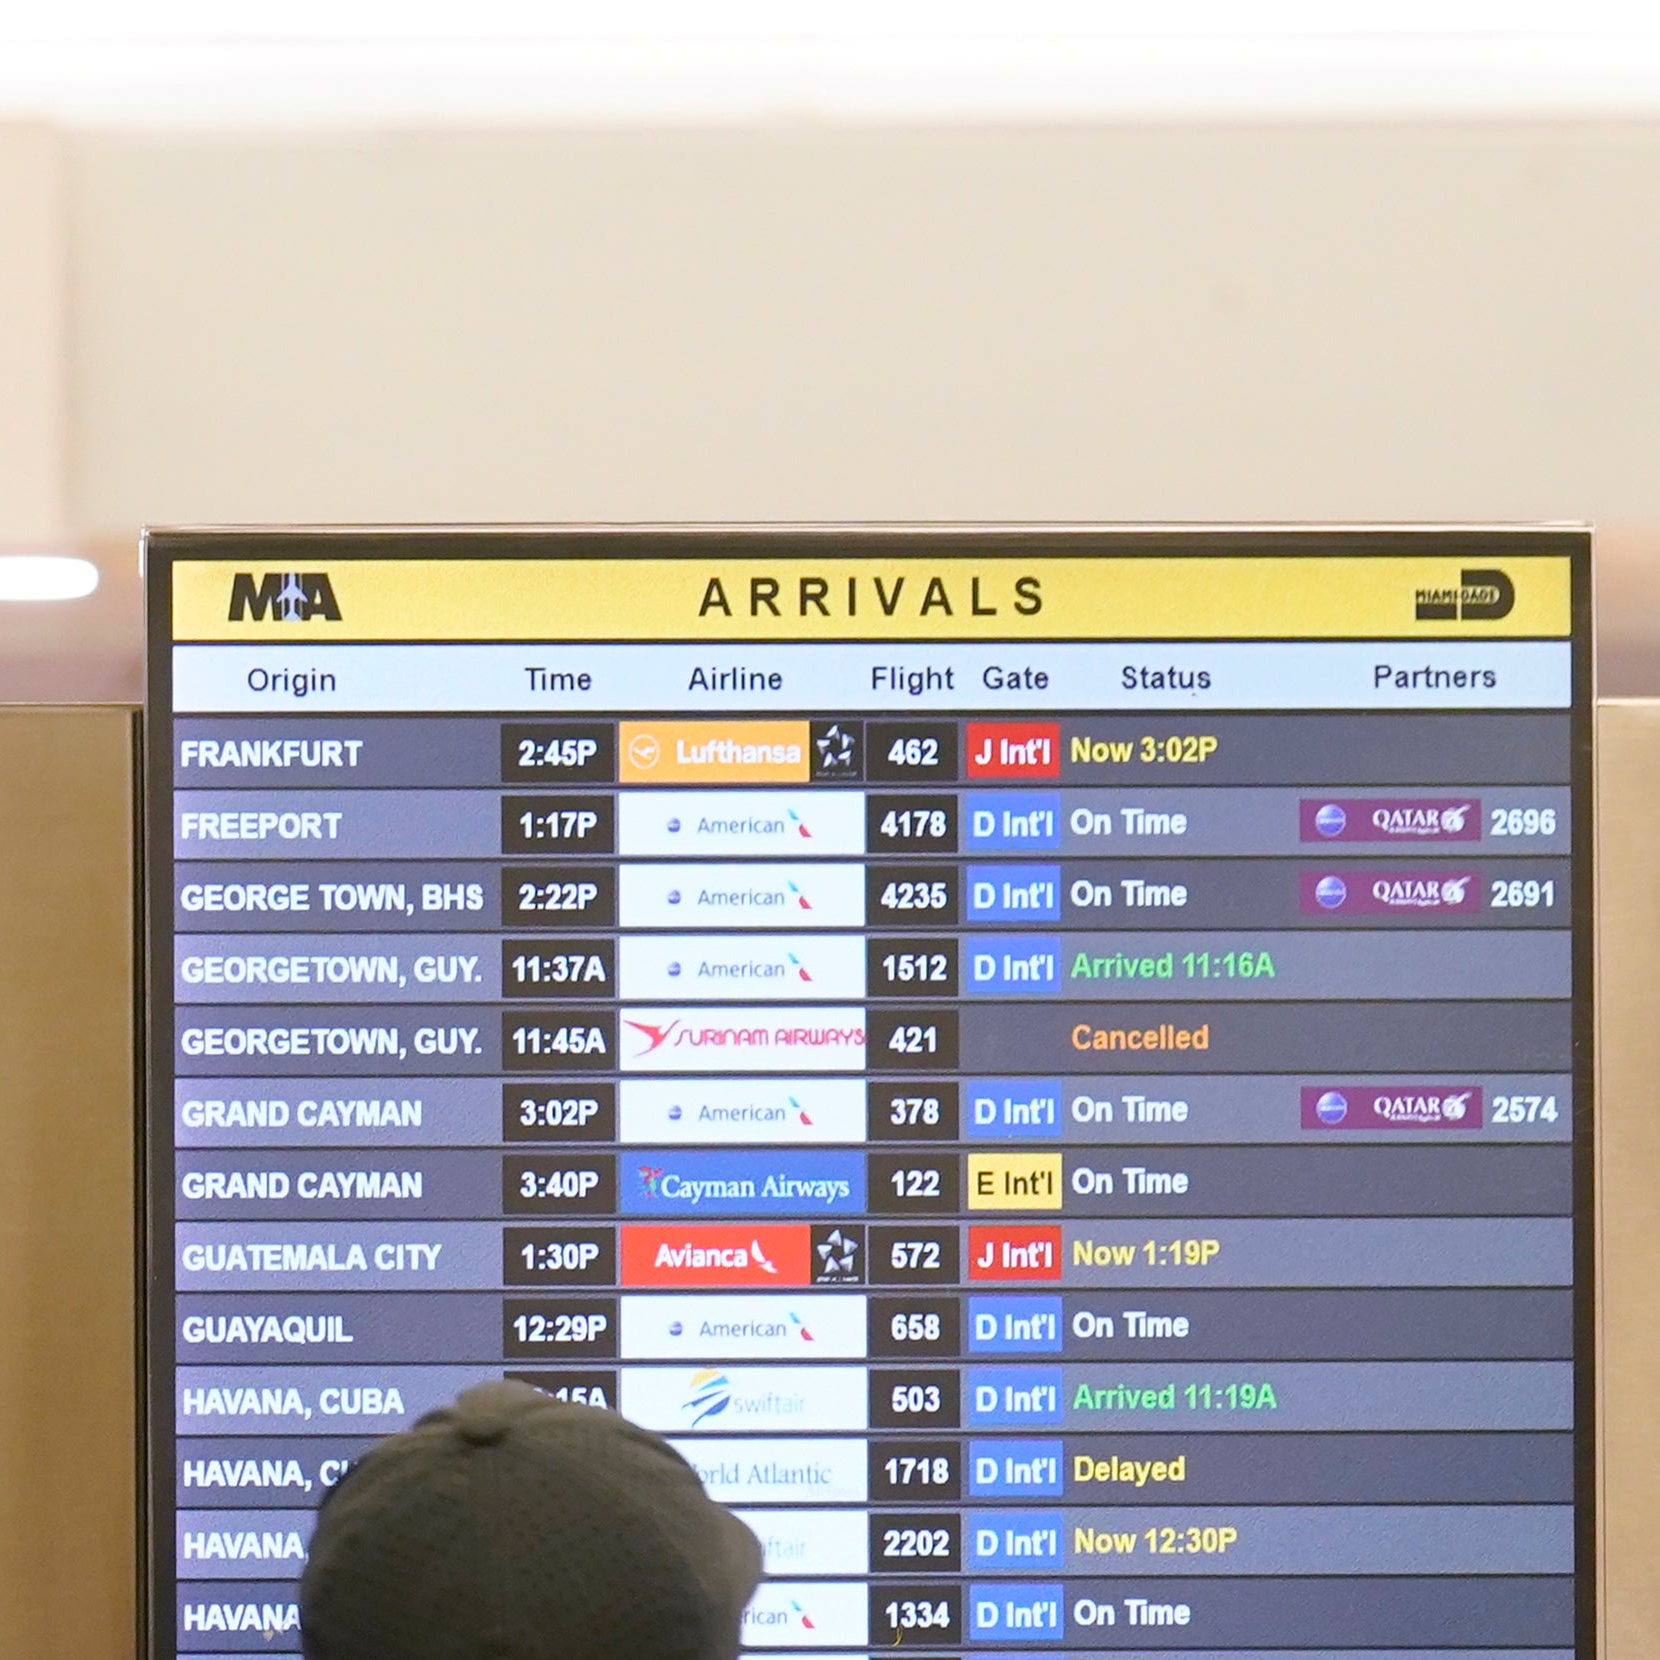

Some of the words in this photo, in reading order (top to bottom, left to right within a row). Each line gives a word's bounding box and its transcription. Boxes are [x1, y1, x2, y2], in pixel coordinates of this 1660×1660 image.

[699, 576, 1045, 618] ARRIVALS
[248, 668, 335, 697] Origin
[525, 668, 591, 690] Time
[689, 667, 782, 690] Airline
[873, 667, 954, 695] Flight
[983, 666, 1048, 689] Gate
[1122, 666, 1211, 689] Status
[1375, 665, 1496, 688] Partners
[181, 741, 363, 767] FRANKFURT
[677, 739, 801, 763] Lufthansa
[888, 739, 938, 765] 462
[975, 739, 991, 764] J
[1001, 739, 1050, 764] Int'l
[1072, 737, 1133, 762] Now
[1141, 737, 1217, 762] 3:02P
[181, 813, 342, 839] FREEPORT
[1373, 809, 1439, 834] QATAR
[1491, 809, 1555, 835] 2696
[181, 957, 406, 987] GEORGETOWN,
[414, 956, 481, 982] GUY.
[1071, 953, 1172, 978] Arrived
[1183, 952, 1275, 977] 11:16A
[775, 1020, 865, 1047] AIRWAYS
[1072, 1025, 1208, 1049] Cancelled
[182, 1173, 289, 1198] GRAND
[298, 1172, 422, 1198] CAYMAN
[661, 1175, 755, 1204] Cayman
[761, 1174, 849, 1203] Airways
[978, 1172, 994, 1195] E
[1006, 1171, 1052, 1195] Int'l
[182, 1244, 367, 1271] GUATEMALA
[375, 1244, 442, 1270] CITY
[655, 1243, 748, 1267] Avianca
[892, 1242, 940, 1268] 572
[183, 1316, 353, 1344] GUAYAQUIL
[184, 1389, 311, 1420] HAVANA,
[320, 1388, 404, 1414] CUBA
[734, 1392, 804, 1414] swiftair
[1075, 1456, 1185, 1487] Delayed
